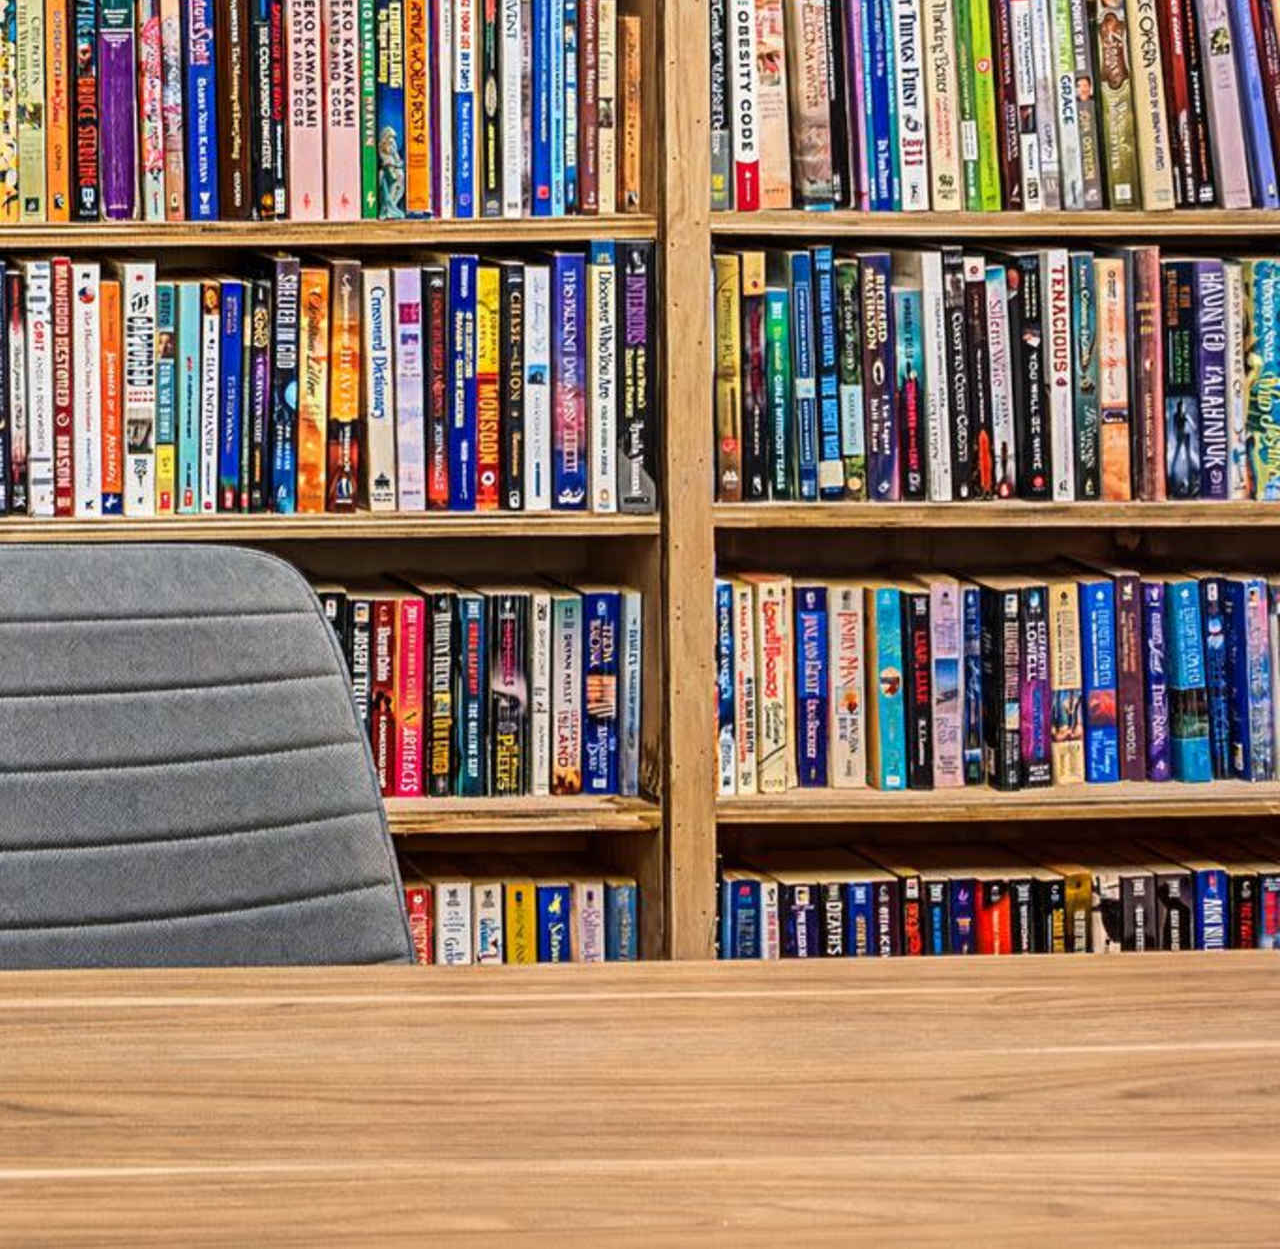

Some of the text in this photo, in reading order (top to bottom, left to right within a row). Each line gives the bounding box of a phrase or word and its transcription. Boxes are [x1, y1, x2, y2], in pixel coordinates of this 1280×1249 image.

[898, 13, 917, 62] THINGS
[930, 0, 949, 53] Thinking
[1137, 19, 1156, 68] OPERA
[291, 47, 303, 84] AND
[303, 37, 316, 128] KAWAKAMI
[341, 37, 354, 128] KAWAKAMI
[736, 10, 754, 152] OBESITY CODE
[900, 68, 919, 109] FIRST
[1058, 74, 1074, 125] GRACE
[276, 273, 295, 369] SHELTER IN GOD
[597, 270, 613, 323] Discover
[872, 273, 887, 342] RICHARD
[1051, 265, 1067, 373] TENACIOUS
[127, 316, 151, 388] CAPTURED
[597, 326, 613, 353] Who
[53, 265, 71, 487] MANHOOD RESTORED MASON
[597, 377, 612, 400] Are
[1199, 272, 1221, 468] HAUNTED PALAHNIUK
[478, 383, 497, 464] MONSOON
[838, 610, 859, 655] FAMILY
[1026, 622, 1039, 682] LOWELL
[401, 726, 418, 792] ARTIFACTS
[557, 709, 570, 769] ISLAND
